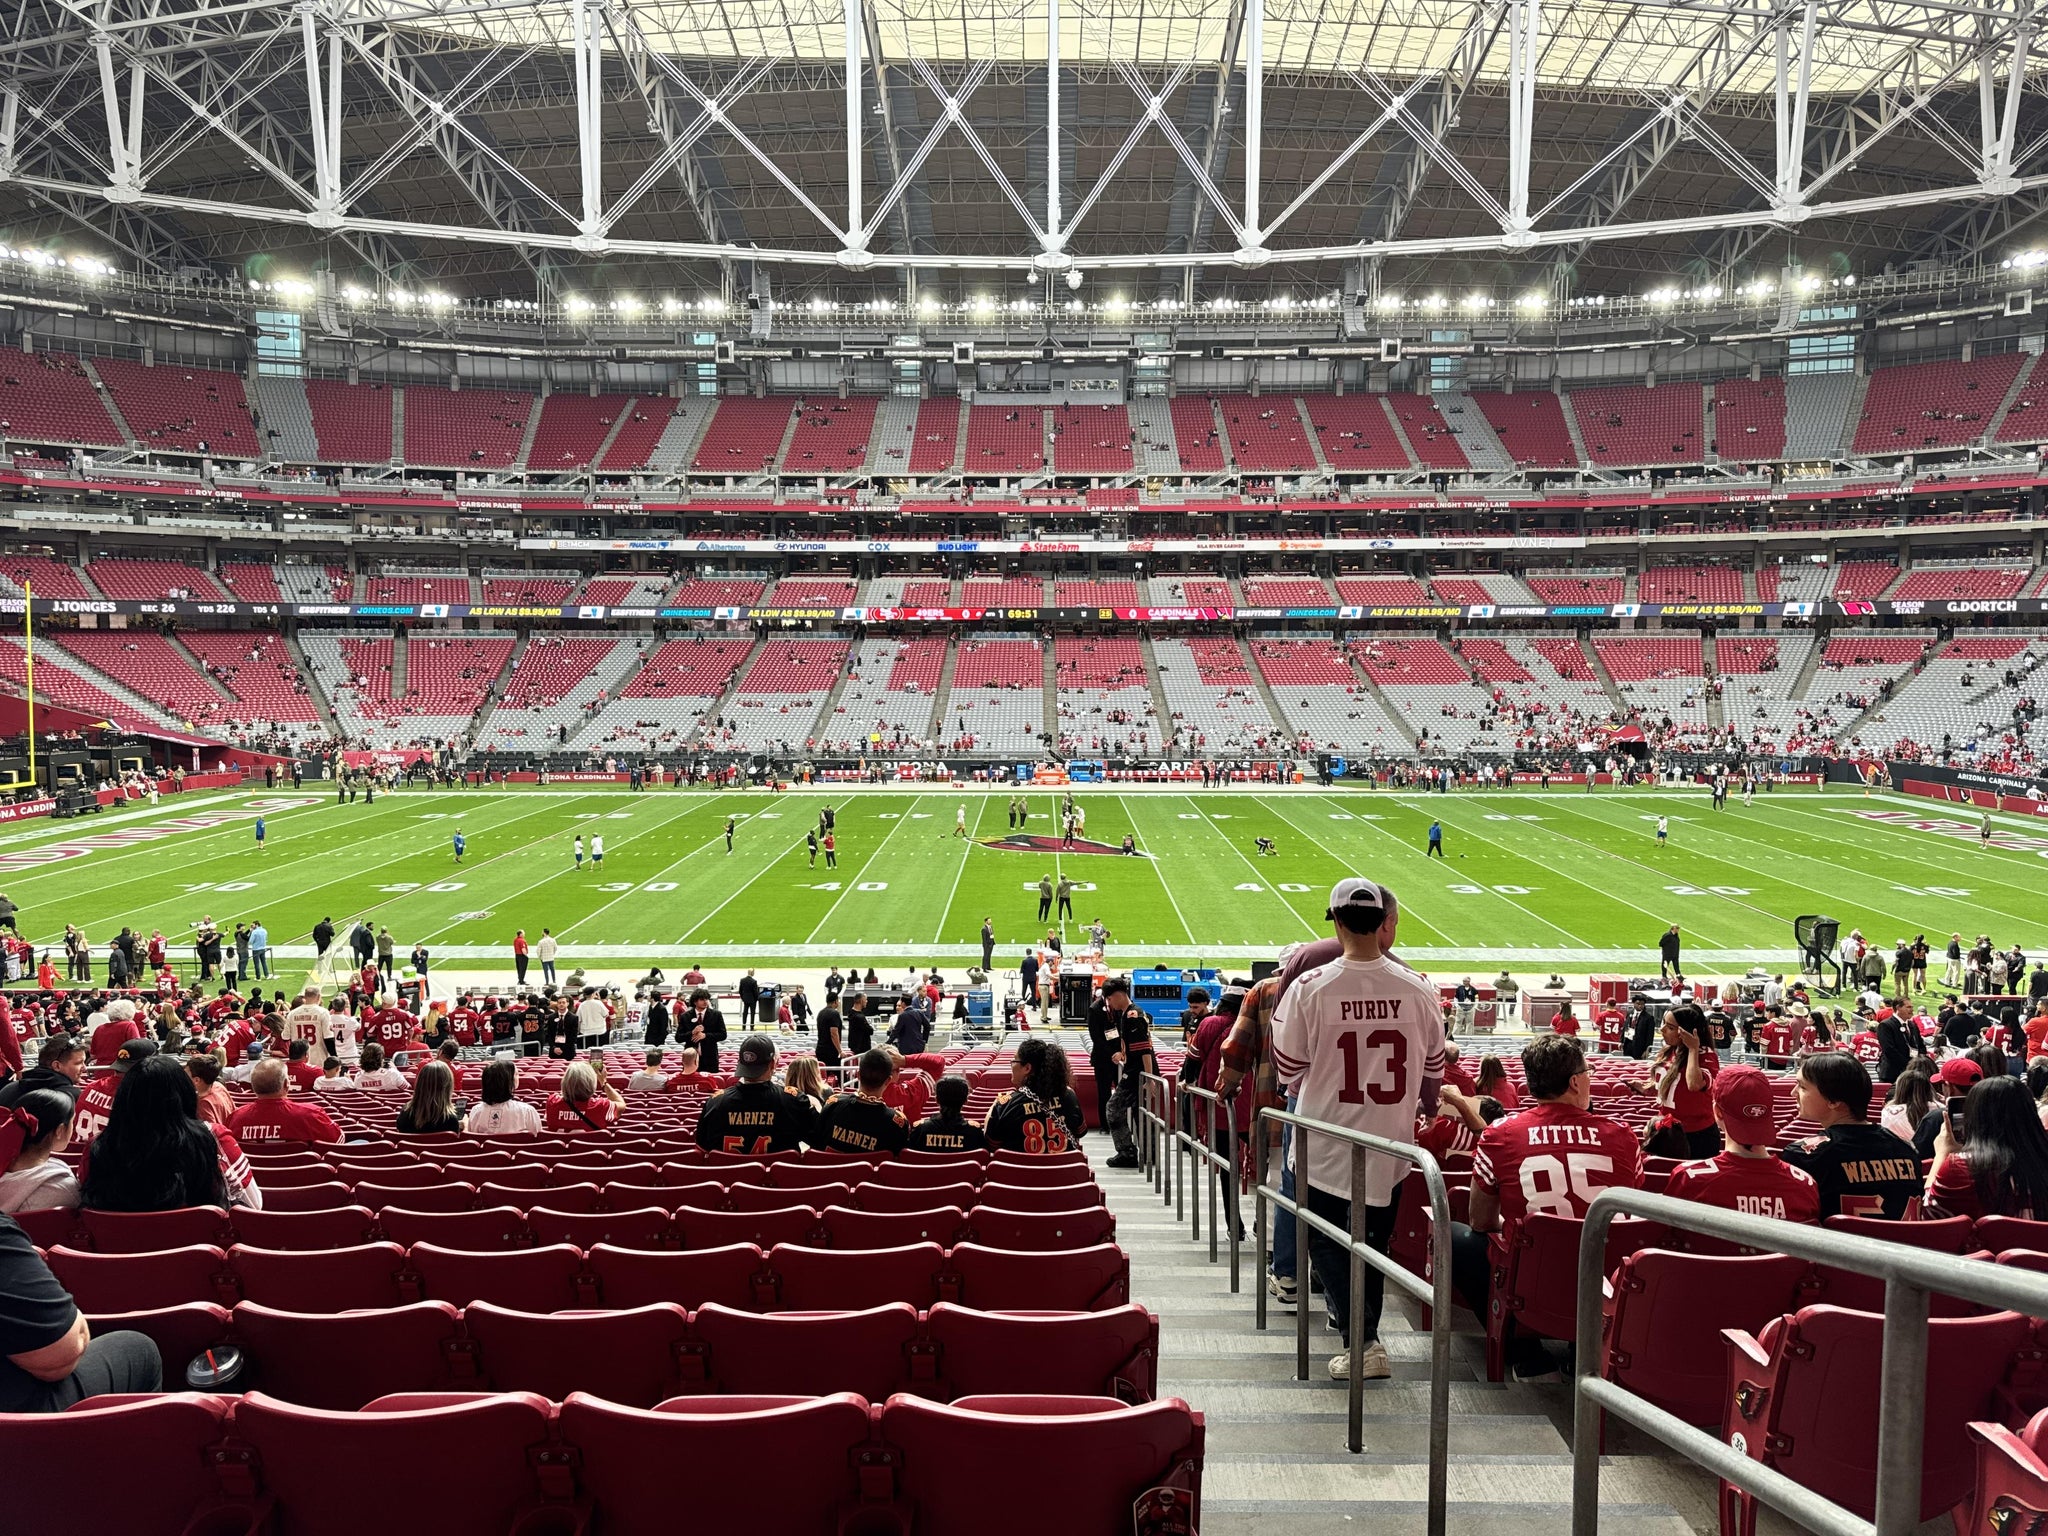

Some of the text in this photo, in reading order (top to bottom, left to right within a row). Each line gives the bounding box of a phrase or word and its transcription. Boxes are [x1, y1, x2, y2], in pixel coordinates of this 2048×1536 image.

[195, 489, 213, 497] ROY
[215, 490, 243, 498] GREEN
[710, 543, 745, 551] Albertsons
[868, 543, 890, 551] COX
[955, 543, 978, 551] LIGHT
[1509, 538, 1554, 549] AVNET
[1, 605, 26, 613] STATS
[52, 601, 117, 612] J.TONGES
[141, 604, 159, 612] REC
[161, 603, 176, 613] 26
[198, 605, 214, 613] YDS
[216, 604, 236, 613] 226
[270, 605, 278, 614] 4
[469, 607, 483, 615] AS
[505, 608, 517, 616] AS
[781, 609, 793, 617] AS
[916, 609, 944, 617] 49ERS
[962, 609, 970, 618] 0
[1008, 609, 1038, 618] 69:51
[1129, 609, 1137, 618] 0
[1148, 608, 1199, 617] CARDINALS
[1406, 608, 1418, 616] AS
[1675, 606, 1698, 614] LOW
[1698, 606, 1712, 614] AS
[1947, 601, 2017, 612] G.DORTCH
[1957, 772, 2027, 789] ARIZONA CARDINALS
[20, 801, 57, 815] CARDIN
[378, 882, 469, 893] 20
[598, 882, 681, 892] 30
[809, 882, 889, 891] 40
[1233, 882, 1311, 892] 40
[1446, 884, 1533, 895] 30
[1663, 886, 1752, 896] 20
[1341, 1000, 1401, 1020] PURDY
[382, 1022, 403, 1040] 99
[454, 1019, 468, 1032] 54
[496, 1022, 511, 1033] 97
[523, 1020, 539, 1033] 85
[1604, 1022, 1619, 1034] 54
[296, 1024, 316, 1046] 18
[336, 1030, 344, 1043] 4
[1778, 1036, 1784, 1053] 1
[1337, 1029, 1407, 1105] 13
[85, 1089, 115, 1110] KITTL
[1023, 1096, 1062, 1115] KITLE
[728, 1112, 775, 1126] WARNER
[242, 1125, 281, 1140] KITTLE
[832, 1125, 878, 1150] WARNER
[1023, 1116, 1068, 1153] 85
[1528, 1126, 1601, 1146] KITTLE
[926, 1134, 965, 1148] KITTLE
[1841, 1158, 1917, 1184] WARNER
[1519, 1153, 1613, 1218] 85
[1736, 1195, 1787, 1220] BOSA
[1735, 1437, 1744, 1452] 35
